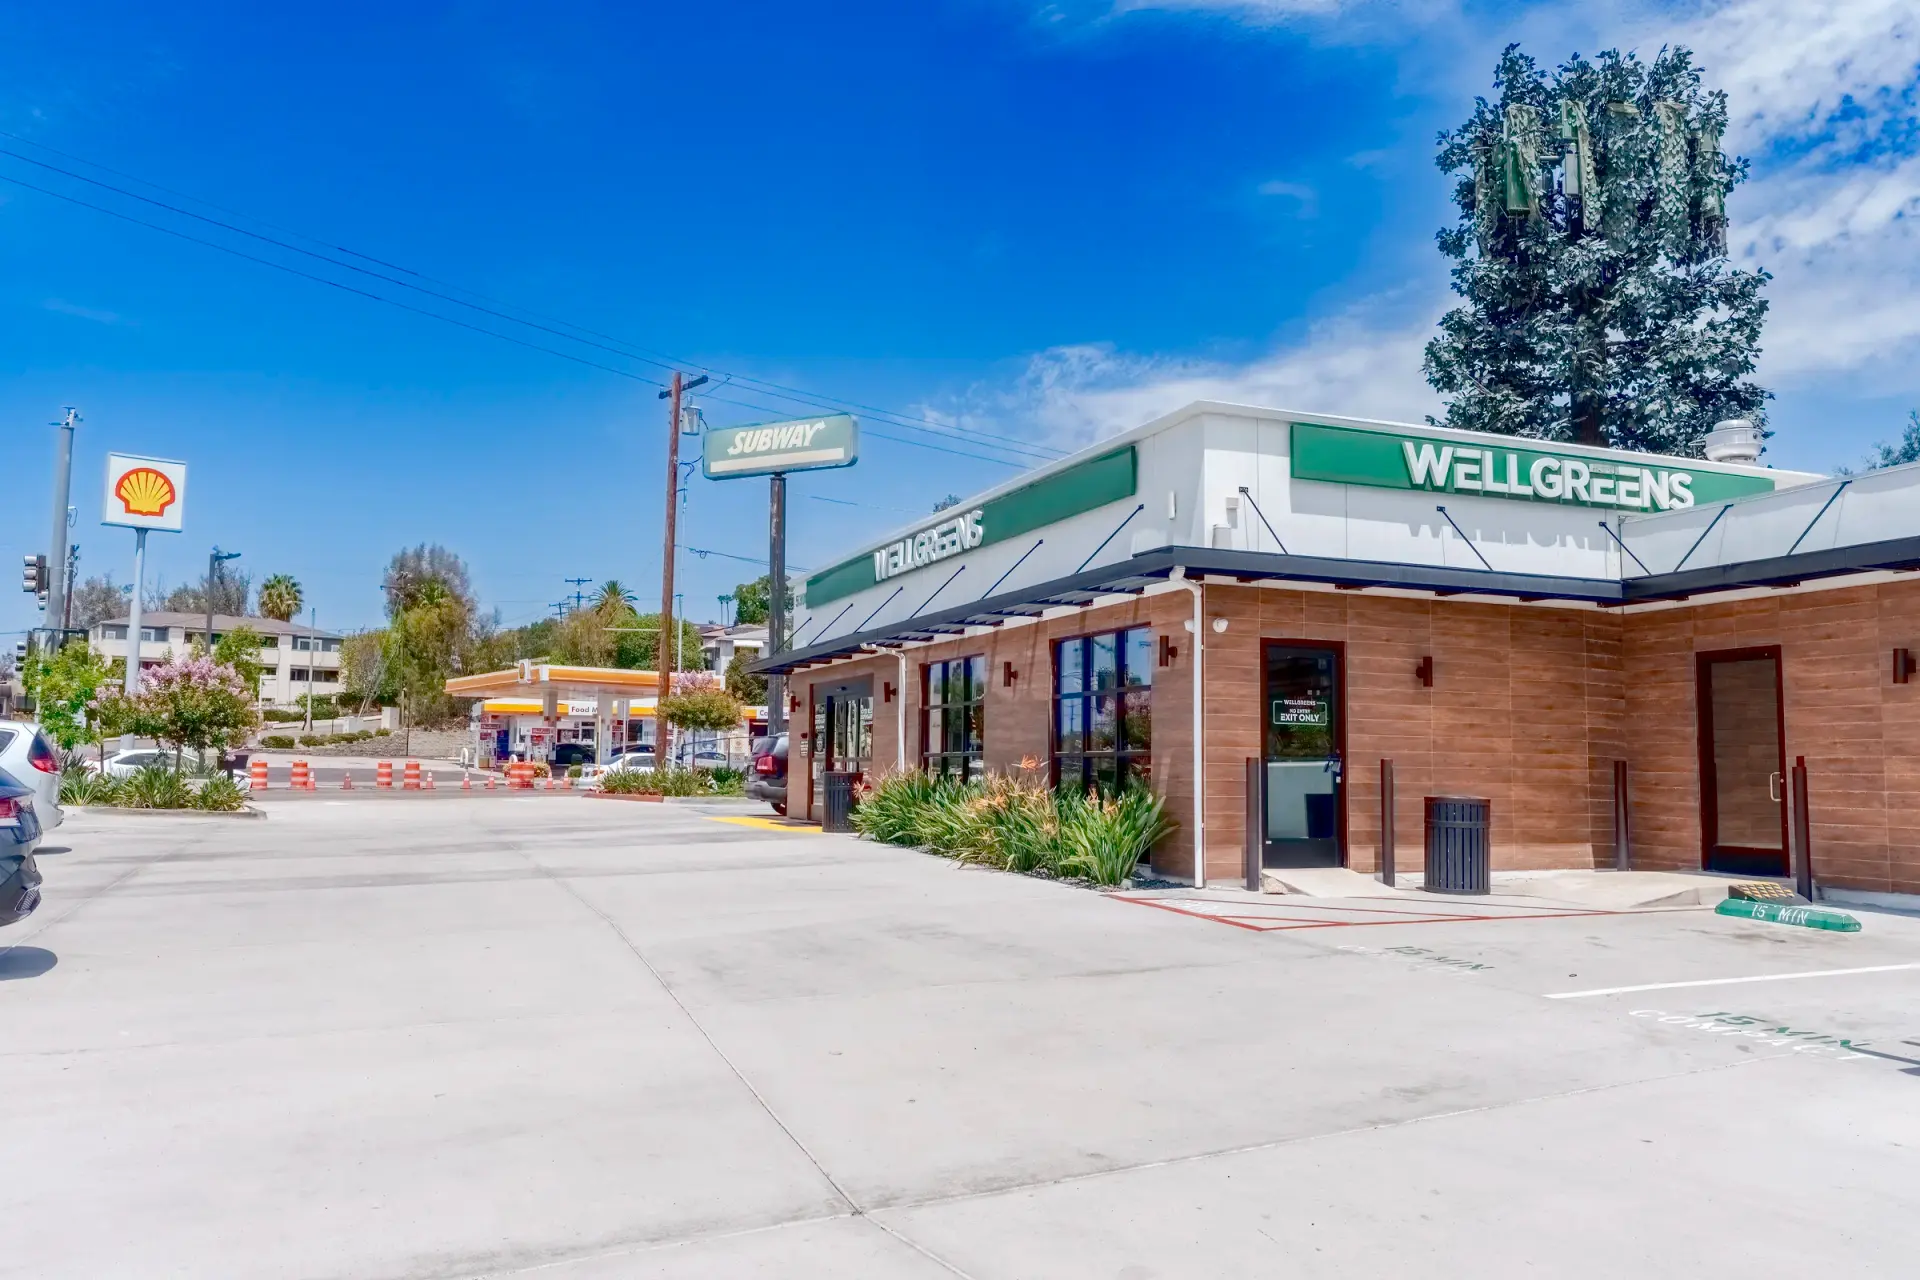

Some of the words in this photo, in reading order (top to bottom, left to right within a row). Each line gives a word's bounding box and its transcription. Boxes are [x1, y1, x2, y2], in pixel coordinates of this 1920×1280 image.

[727, 420, 826, 456] SUBWAY
[1403, 441, 1695, 511] WELLGREENS
[873, 510, 983, 581] WELLGREENS
[1299, 714, 1319, 722] ONLY
[1751, 904, 1768, 918] 15
[1778, 907, 1810, 925] MIN
[1696, 1012, 1767, 1025] 15
